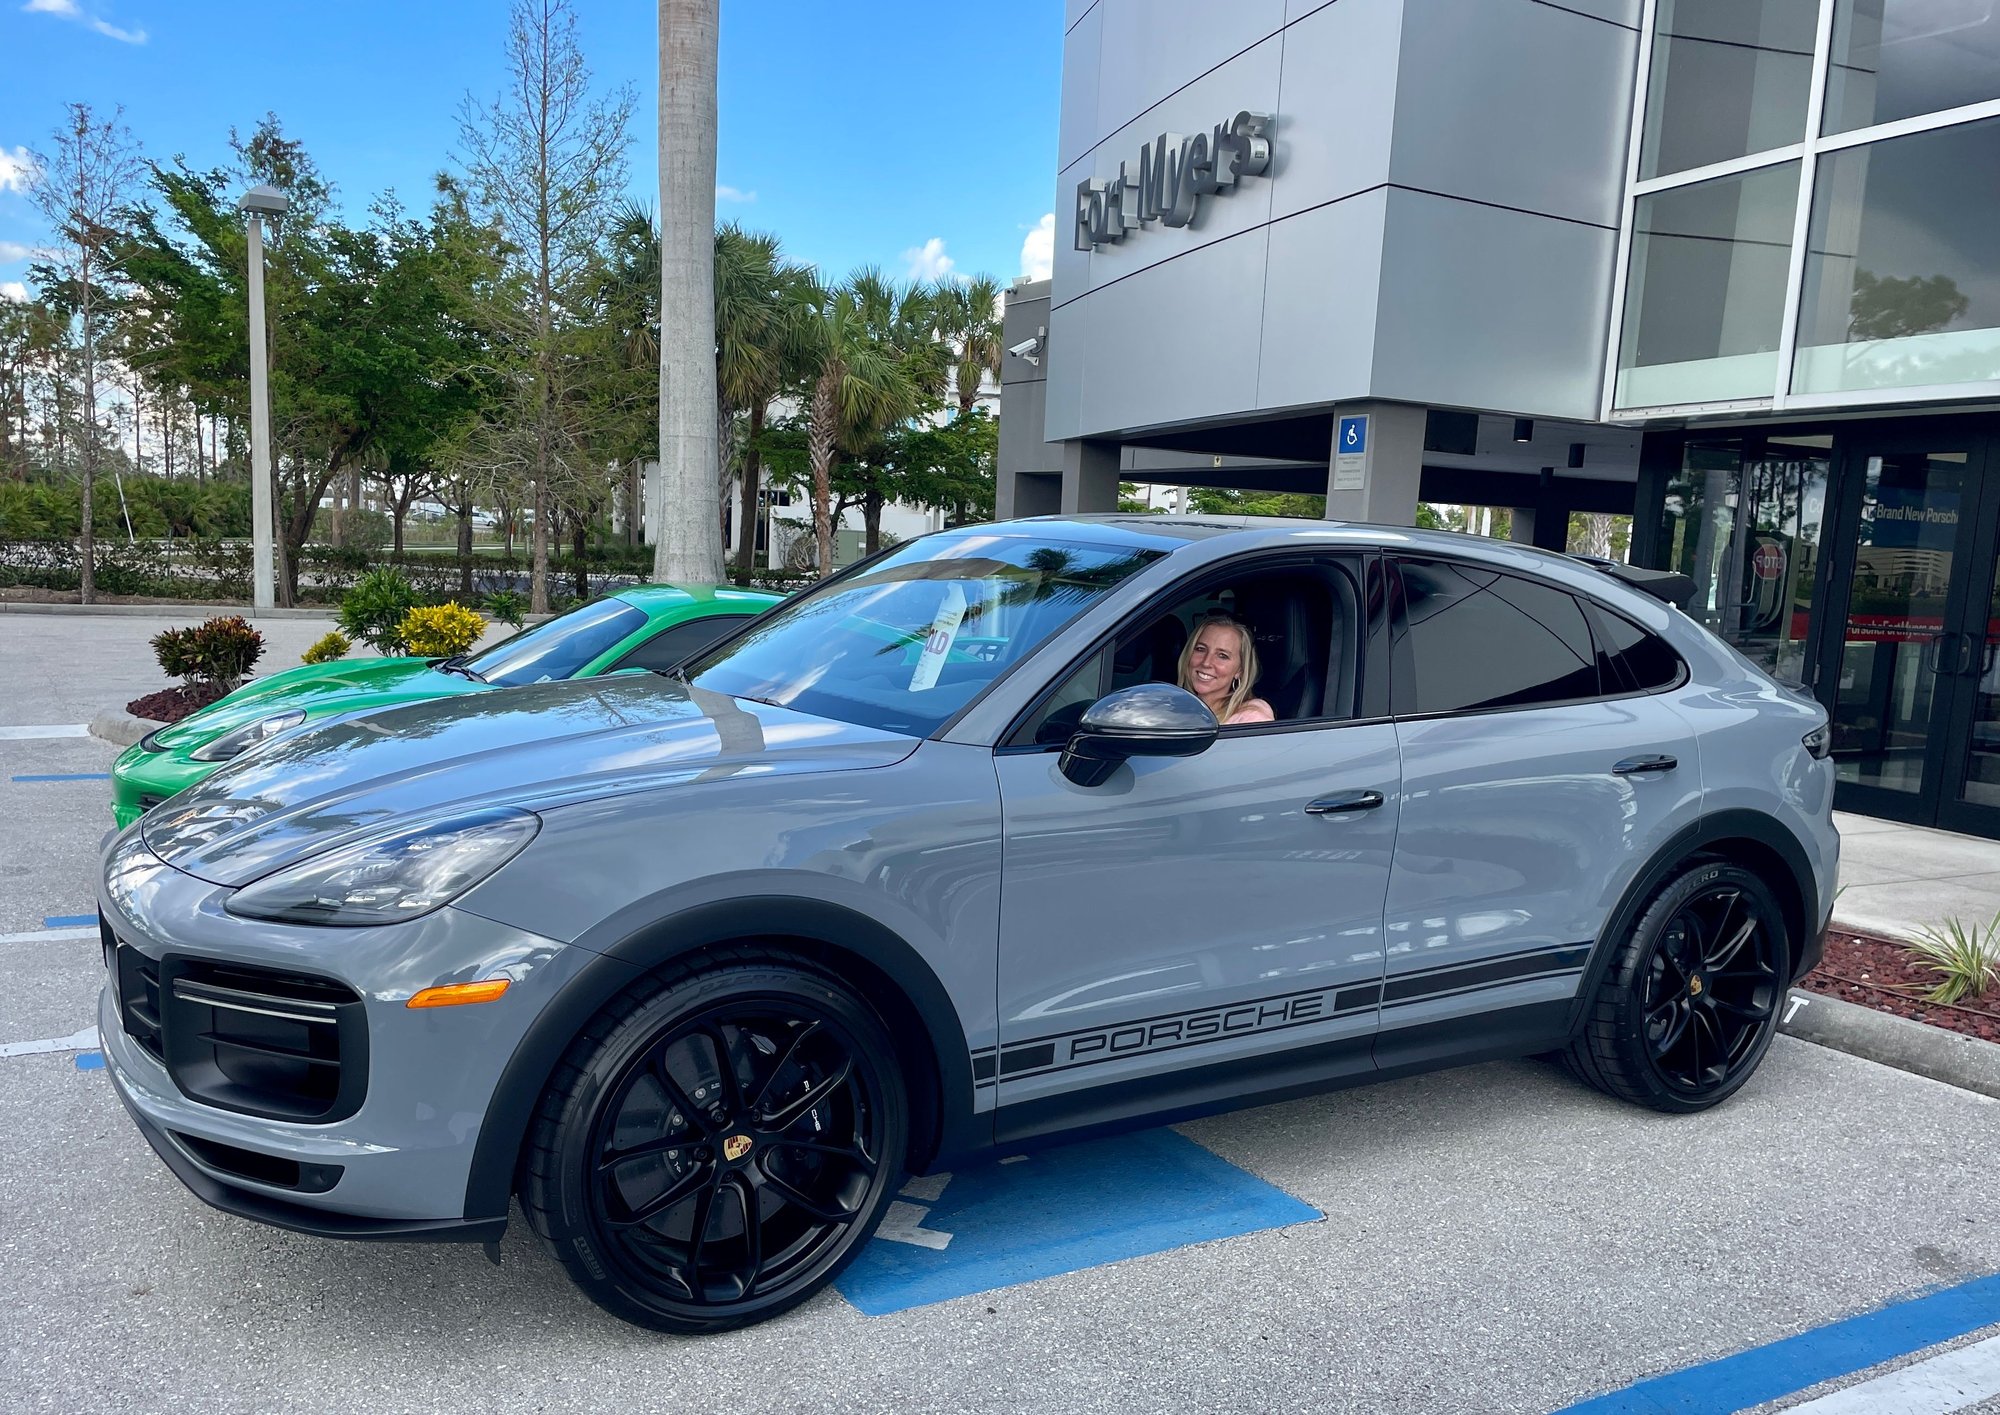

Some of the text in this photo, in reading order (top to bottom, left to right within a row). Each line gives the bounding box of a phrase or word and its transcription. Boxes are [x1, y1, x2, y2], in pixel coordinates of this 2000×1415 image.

[1075, 111, 1268, 251] Fort Myers
[1876, 503, 1904, 520] Brand
[1905, 506, 1925, 522] New
[1070, 995, 1323, 1061] PORSCHE
